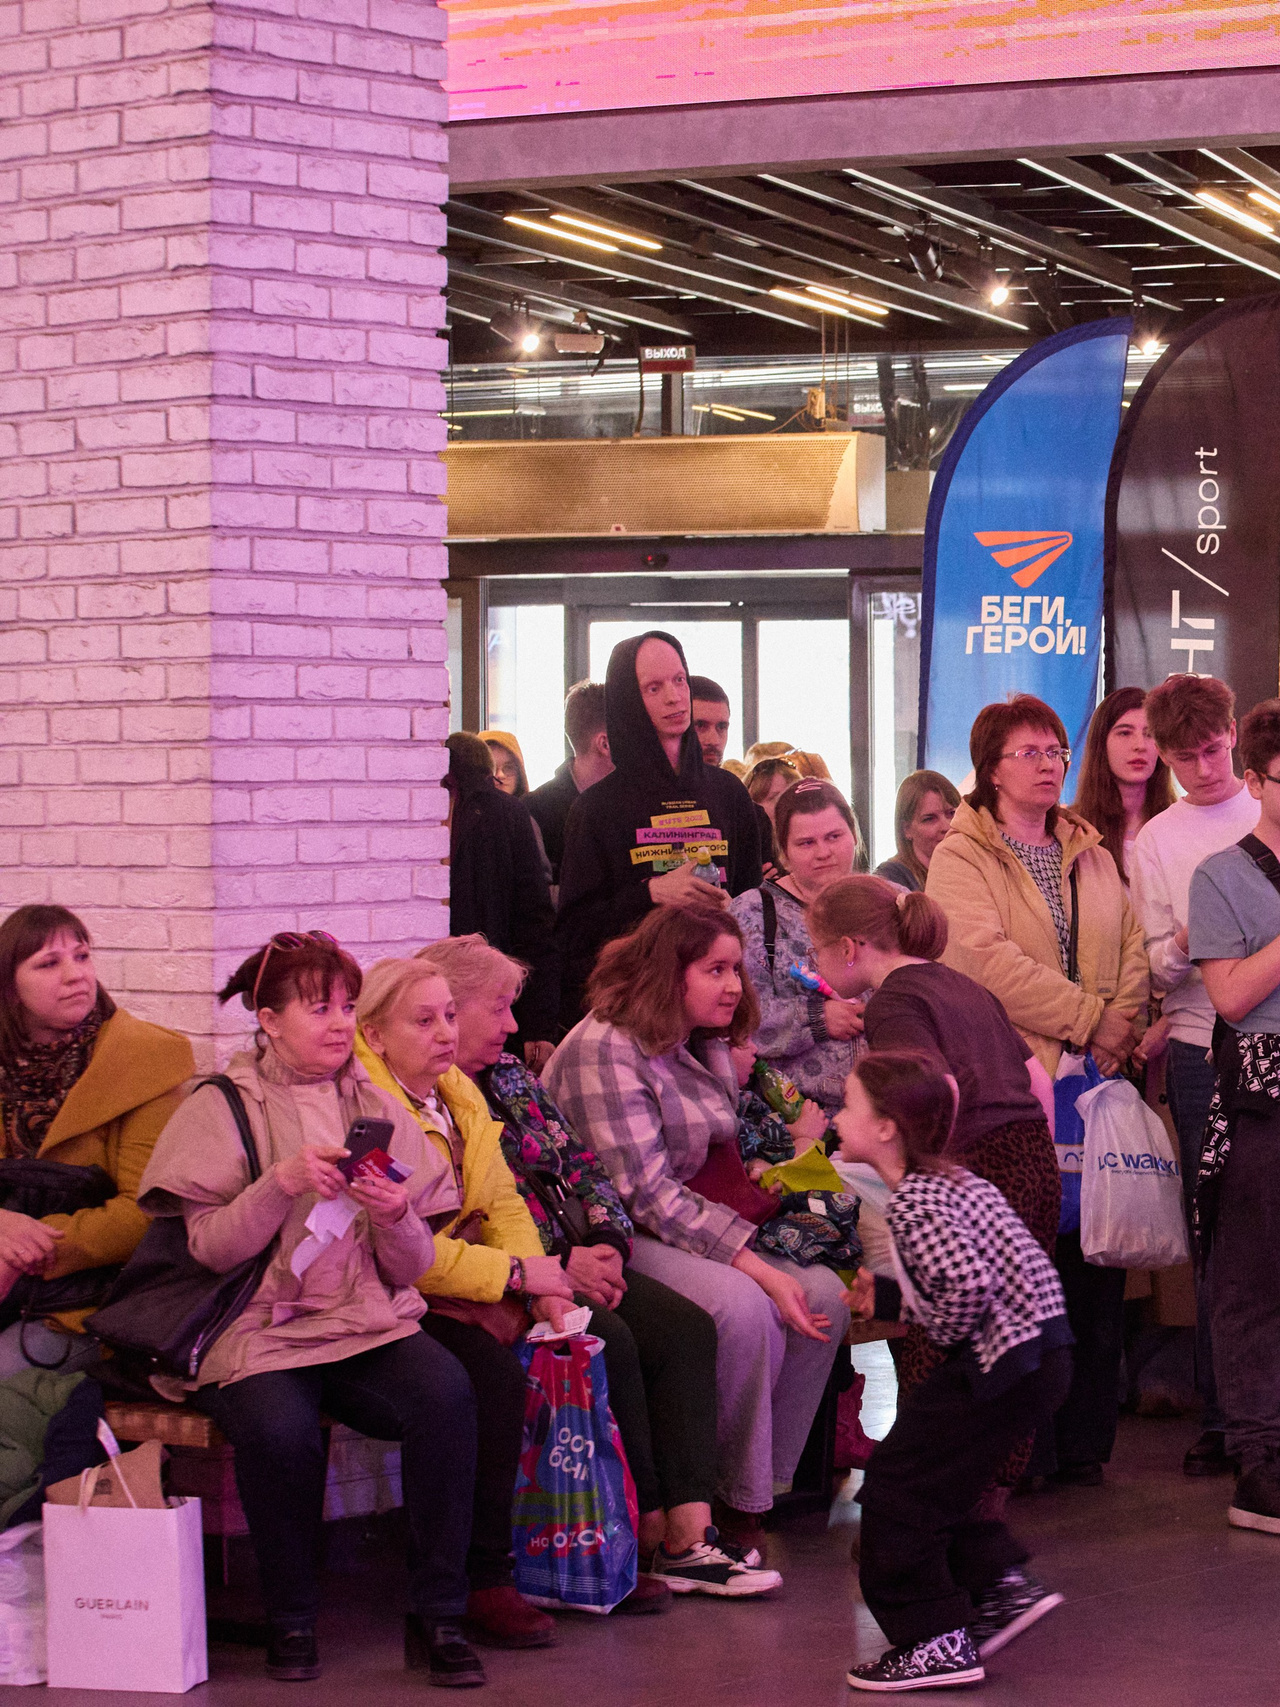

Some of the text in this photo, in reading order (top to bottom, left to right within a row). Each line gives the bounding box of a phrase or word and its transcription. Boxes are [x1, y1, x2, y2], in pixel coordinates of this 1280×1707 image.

[644, 347, 687, 360] ВЫХОД
[1195, 446, 1227, 556] sport
[980, 595, 1073, 628] БЕГИ,
[643, 830, 717, 840] КАЛИНИНГРАД
[74, 1597, 150, 1611] GUERLAIN
